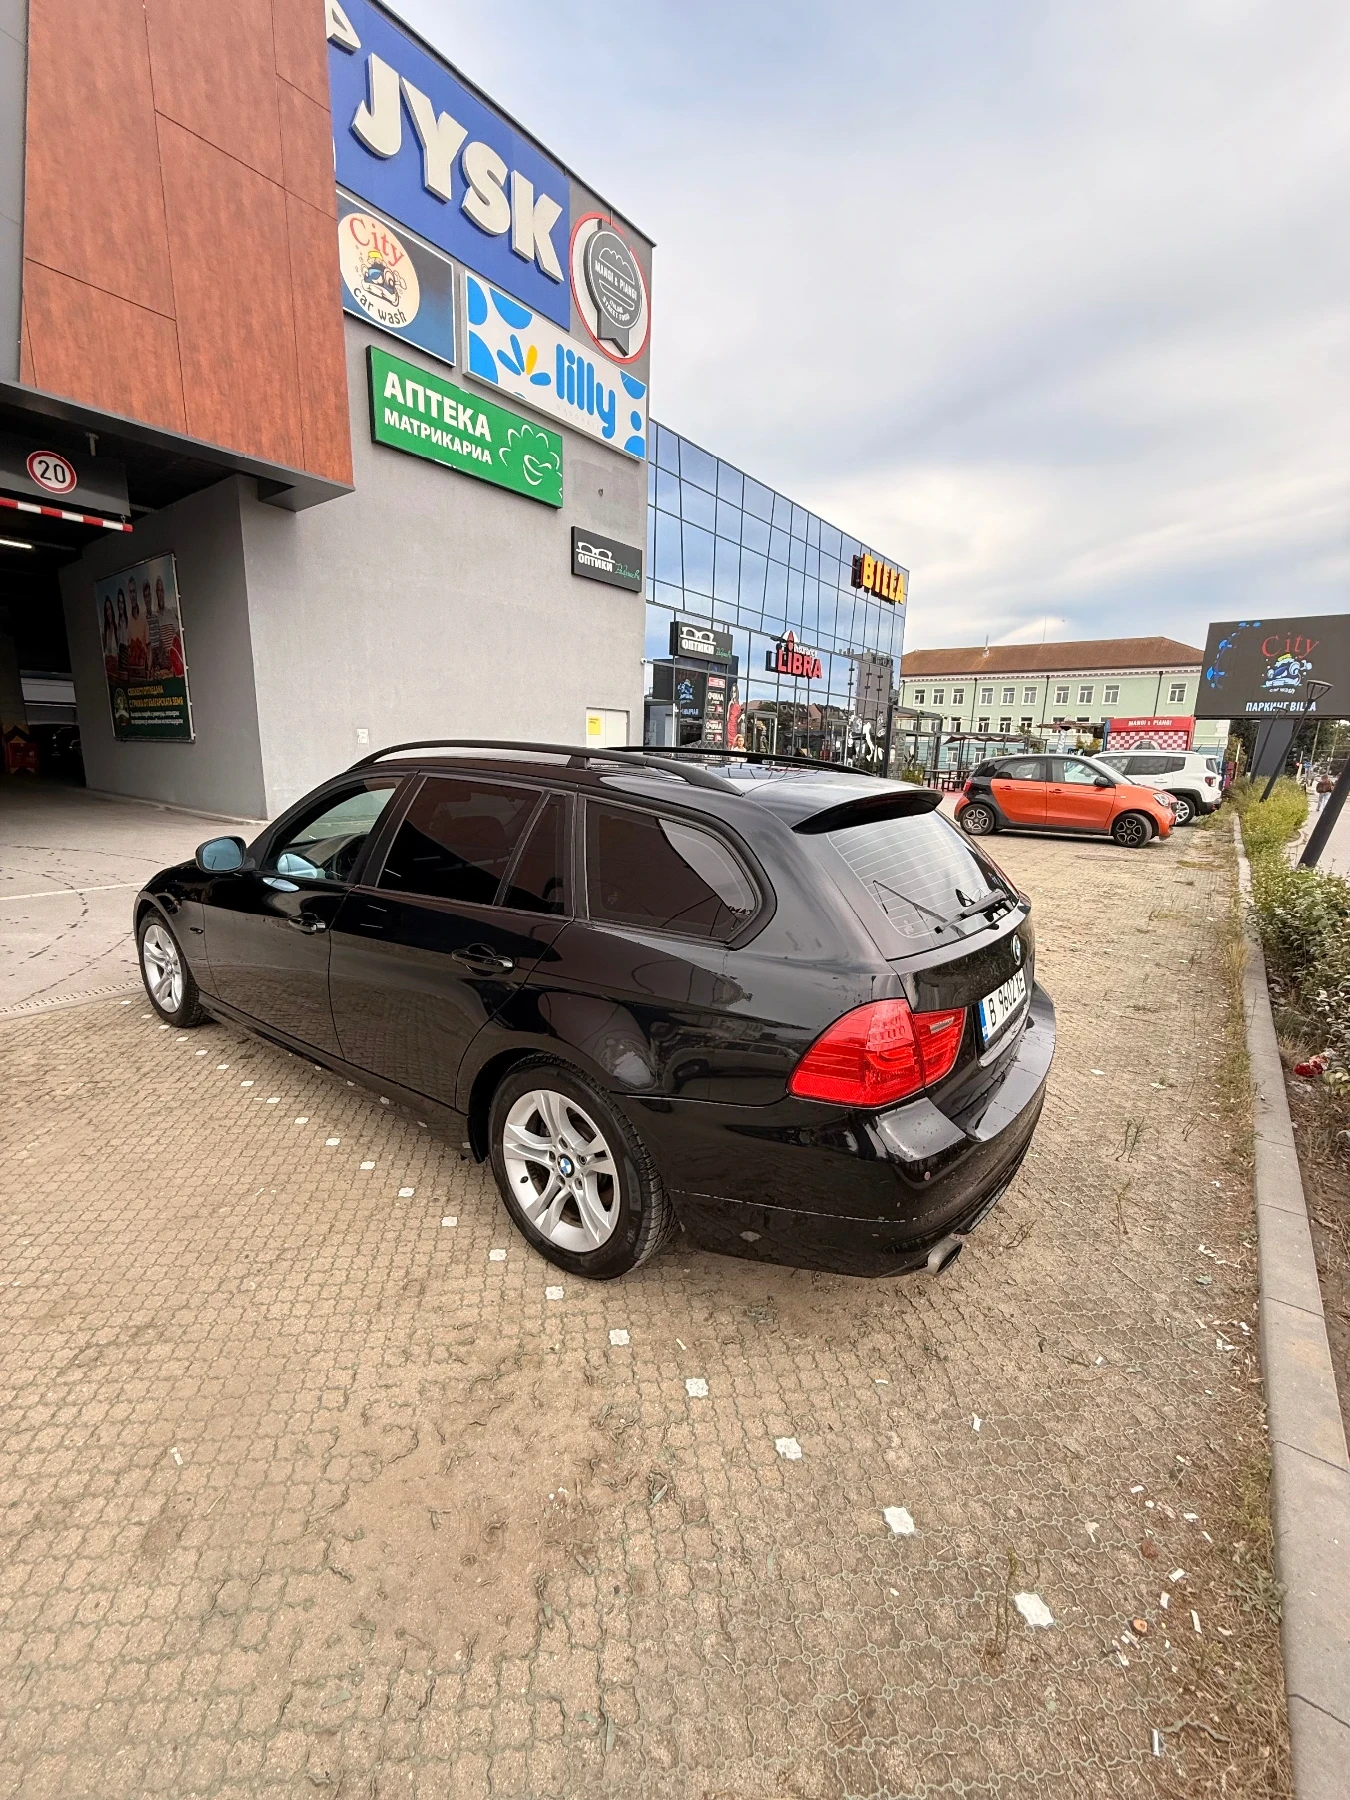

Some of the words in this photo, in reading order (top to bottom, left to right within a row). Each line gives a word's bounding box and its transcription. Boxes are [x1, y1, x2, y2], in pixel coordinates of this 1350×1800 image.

[352, 53, 565, 283] JYSK
[350, 217, 404, 266] City
[595, 260, 613, 283] MANGI
[620, 279, 638, 300] PIANGI
[354, 287, 374, 311] car
[378, 309, 407, 325] wash
[384, 371, 492, 442] АПТЕКА
[556, 343, 616, 439] lilly
[384, 408, 493, 465] МАТРИКАРИА
[38, 460, 66, 483] 20
[578, 553, 613, 572] ОПТИКИ
[681, 639, 714, 655] ОПТИКИ
[777, 649, 823, 679] LIBRA
[1261, 632, 1319, 658] City
[1245, 702, 1289, 712] ПАРКИНГ
[988, 997, 997, 1028] B
[998, 978, 1017, 1017] 9602
